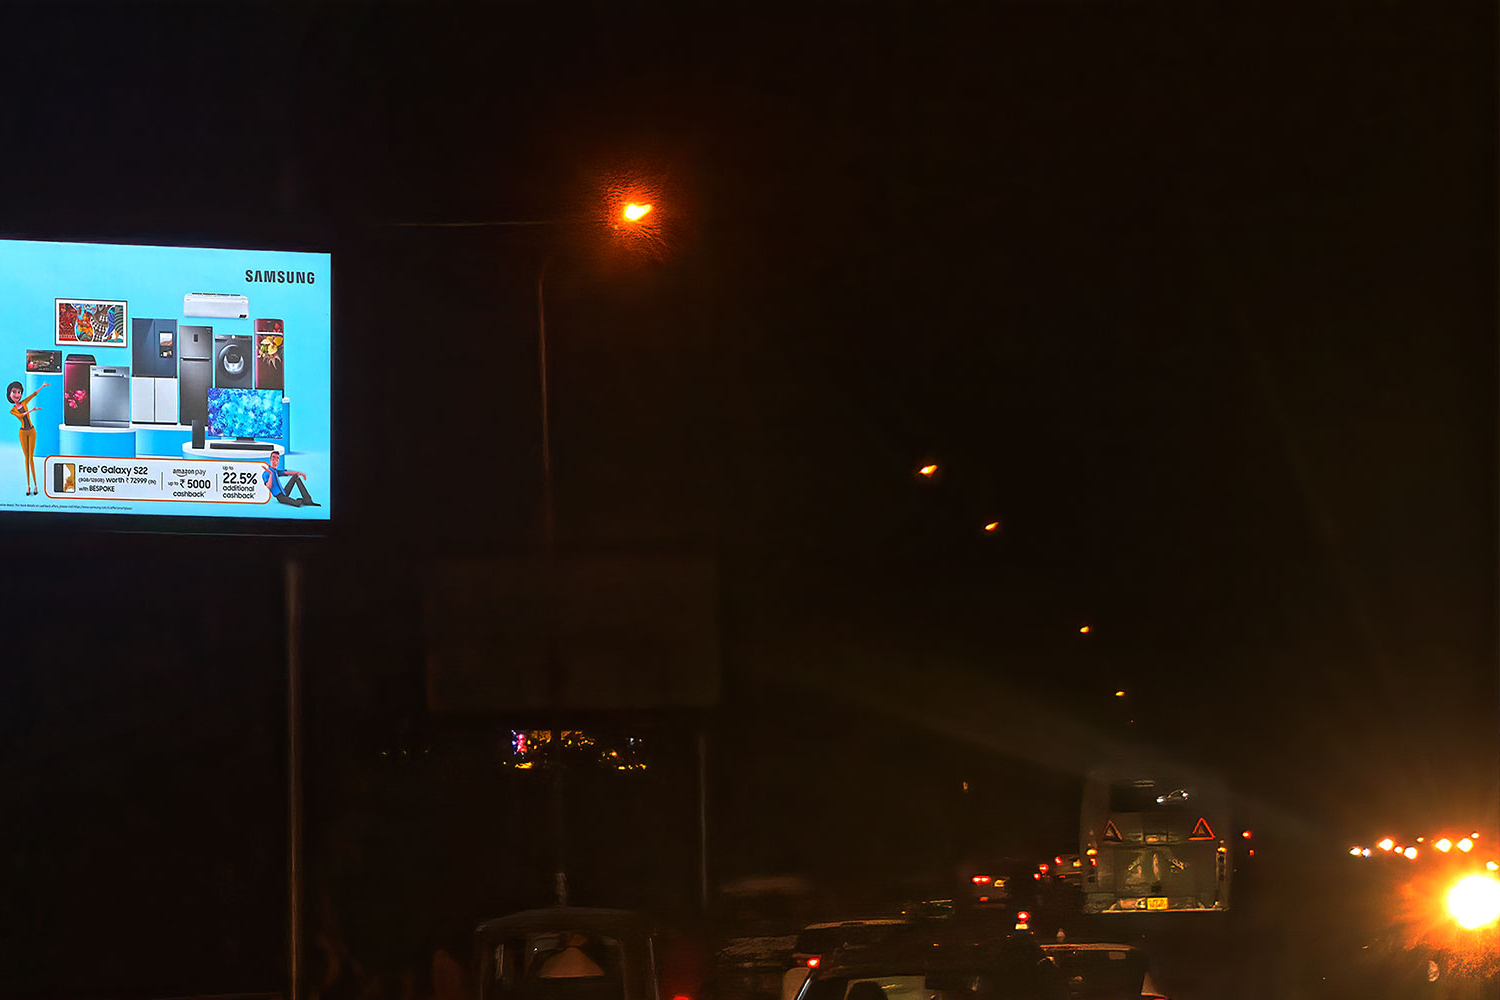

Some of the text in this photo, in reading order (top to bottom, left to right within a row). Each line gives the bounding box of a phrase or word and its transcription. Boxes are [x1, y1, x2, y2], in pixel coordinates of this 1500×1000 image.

[244, 269, 315, 285] SAMSUNG
[100, 465, 131, 476] Galaxy
[133, 466, 148, 475] S22
[187, 479, 211, 489] 5000
[222, 472, 258, 485] 22.5%
[89, 485, 116, 493] BESPOKE
